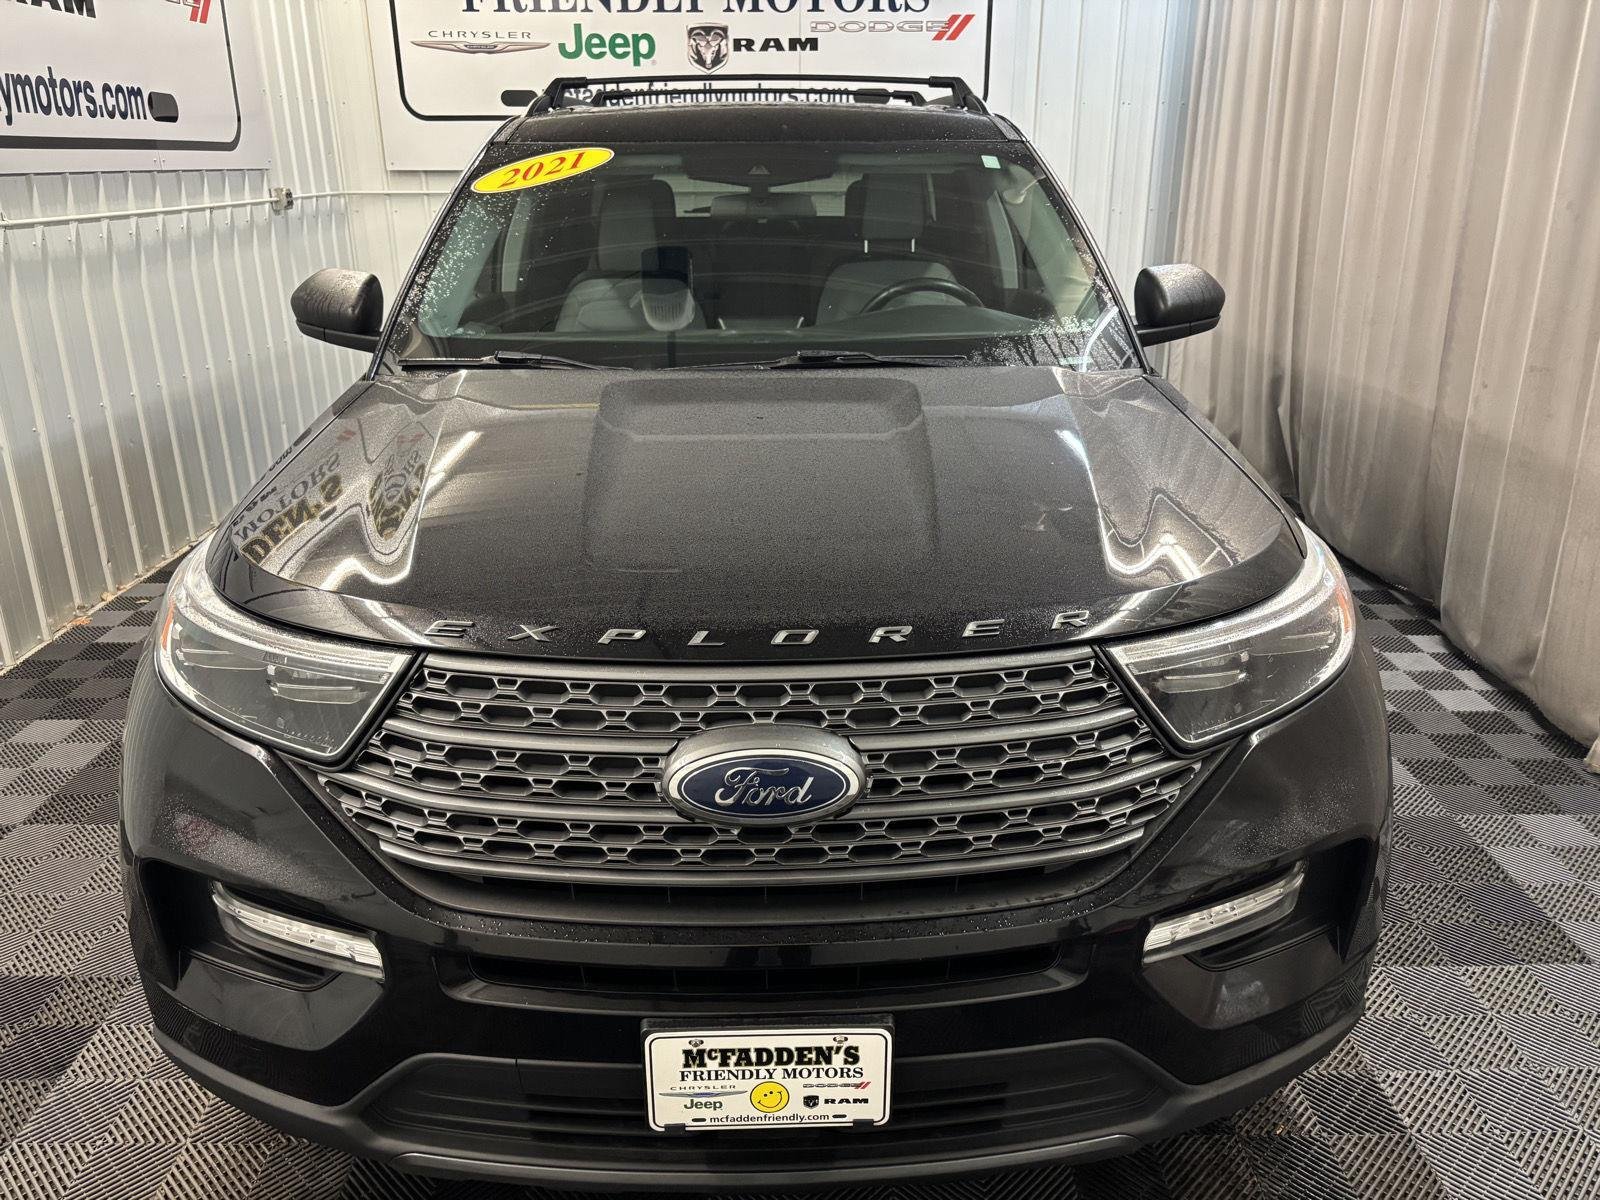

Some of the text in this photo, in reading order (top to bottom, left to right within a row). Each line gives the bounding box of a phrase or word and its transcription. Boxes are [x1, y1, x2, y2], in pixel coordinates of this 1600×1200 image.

[428, 30, 531, 39] CHRYSLER
[810, 20, 950, 33] DODGE
[558, 23, 656, 67] Jeep
[733, 37, 819, 52] RAM
[0, 66, 148, 126] ymotors.com
[498, 151, 586, 189] 2021
[423, 610, 1090, 647] EXPLORER
[714, 766, 815, 807] Ford
[679, 1066, 864, 1082] FRIENDLY MOTORS
[683, 1098, 724, 1111] Jeep
[709, 1112, 829, 1124] mcfaddenfriendly.com
